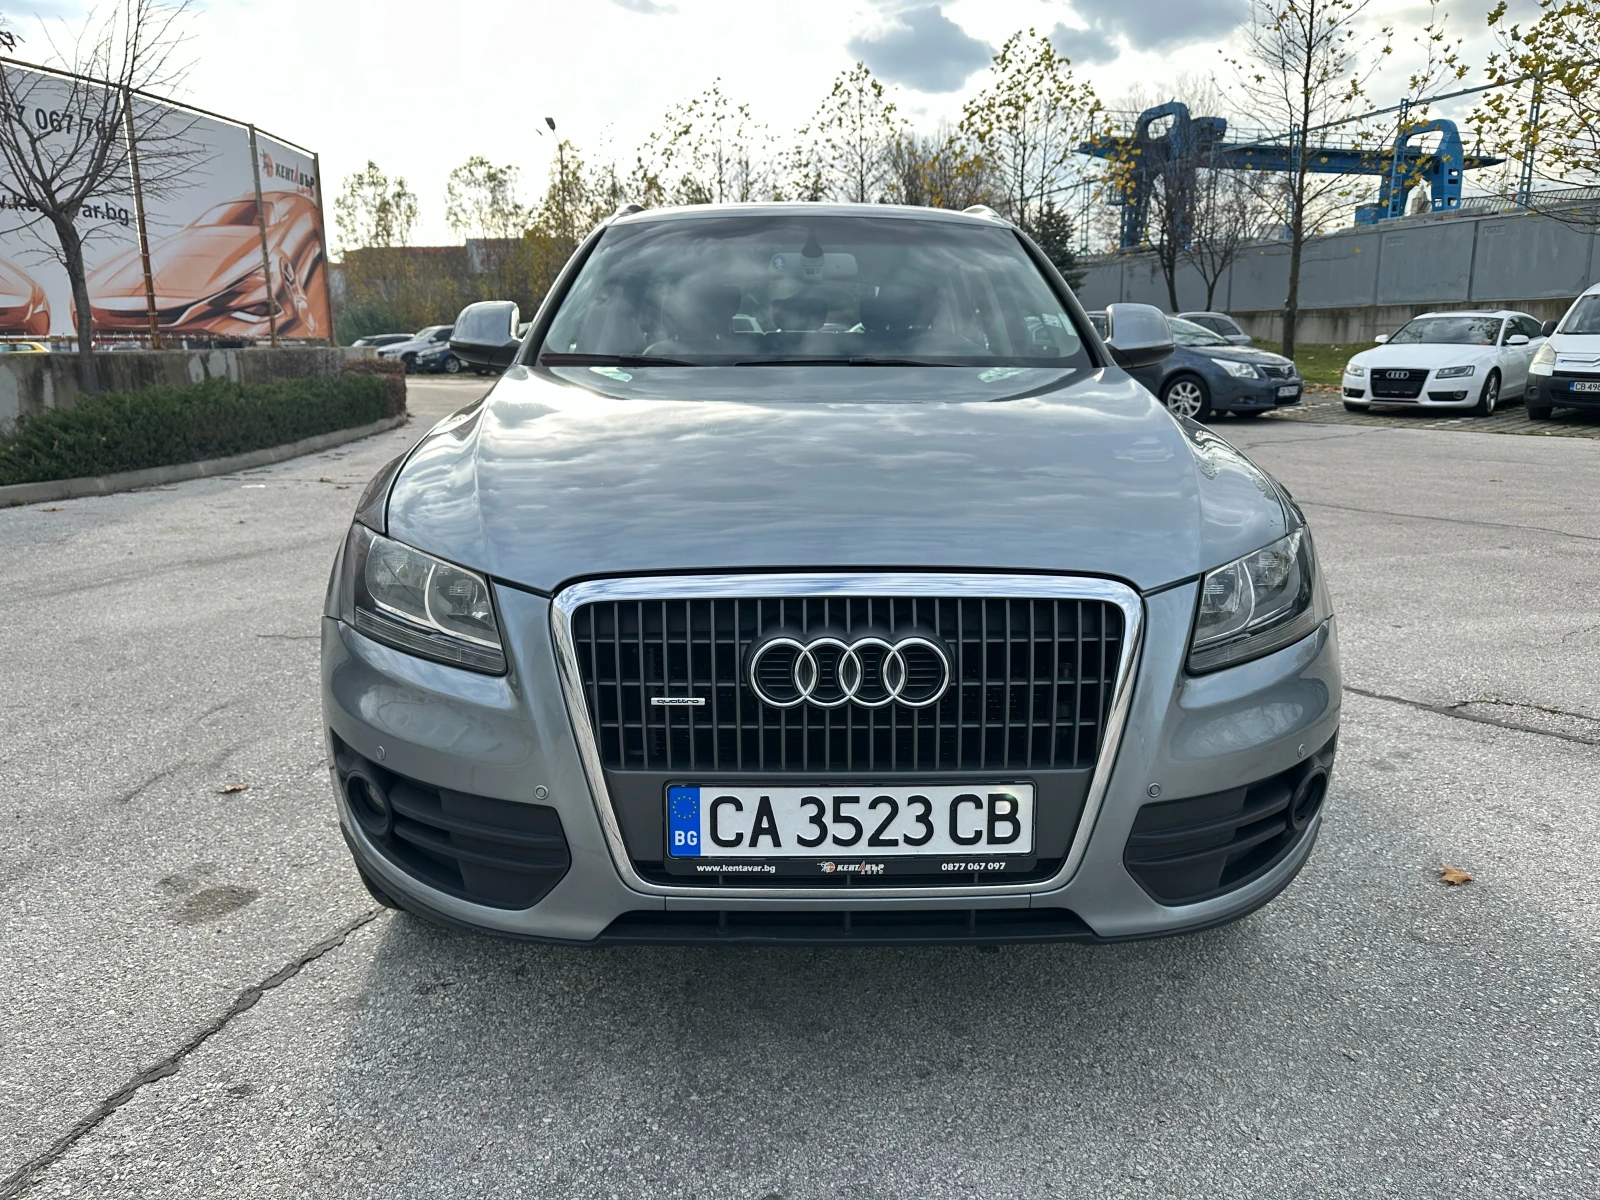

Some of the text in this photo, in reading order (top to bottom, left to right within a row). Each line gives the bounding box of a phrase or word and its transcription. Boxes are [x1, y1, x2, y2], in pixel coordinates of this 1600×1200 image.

[35, 108, 73, 134] 067
[709, 793, 1021, 847] CA 3523 CB
[674, 830, 697, 846] BG
[696, 864, 776, 874] www.kentavar.bg
[941, 861, 1006, 871] 0877 067 097
